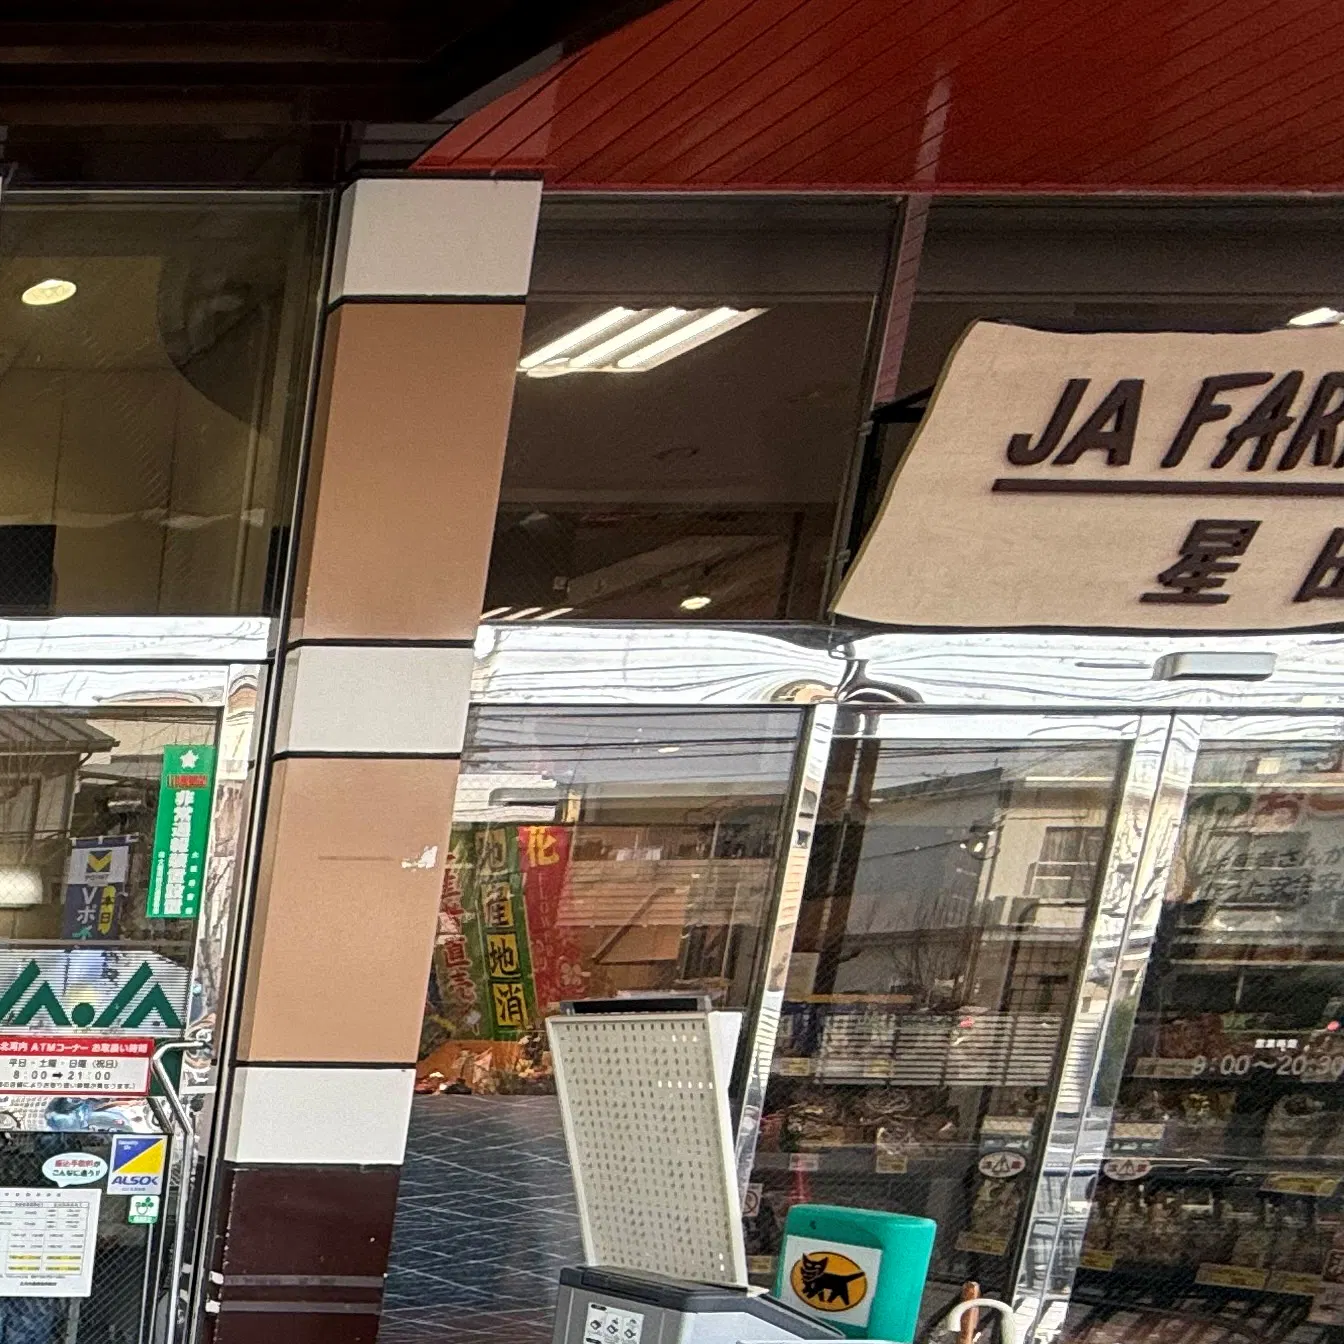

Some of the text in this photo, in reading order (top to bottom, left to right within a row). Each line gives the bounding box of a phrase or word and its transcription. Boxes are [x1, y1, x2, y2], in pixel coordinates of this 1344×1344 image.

[1006, 370, 1344, 472] JA FAR
[30, 1042, 89, 1053] ATMコーナー
[111, 1175, 159, 1186] ALSOK
